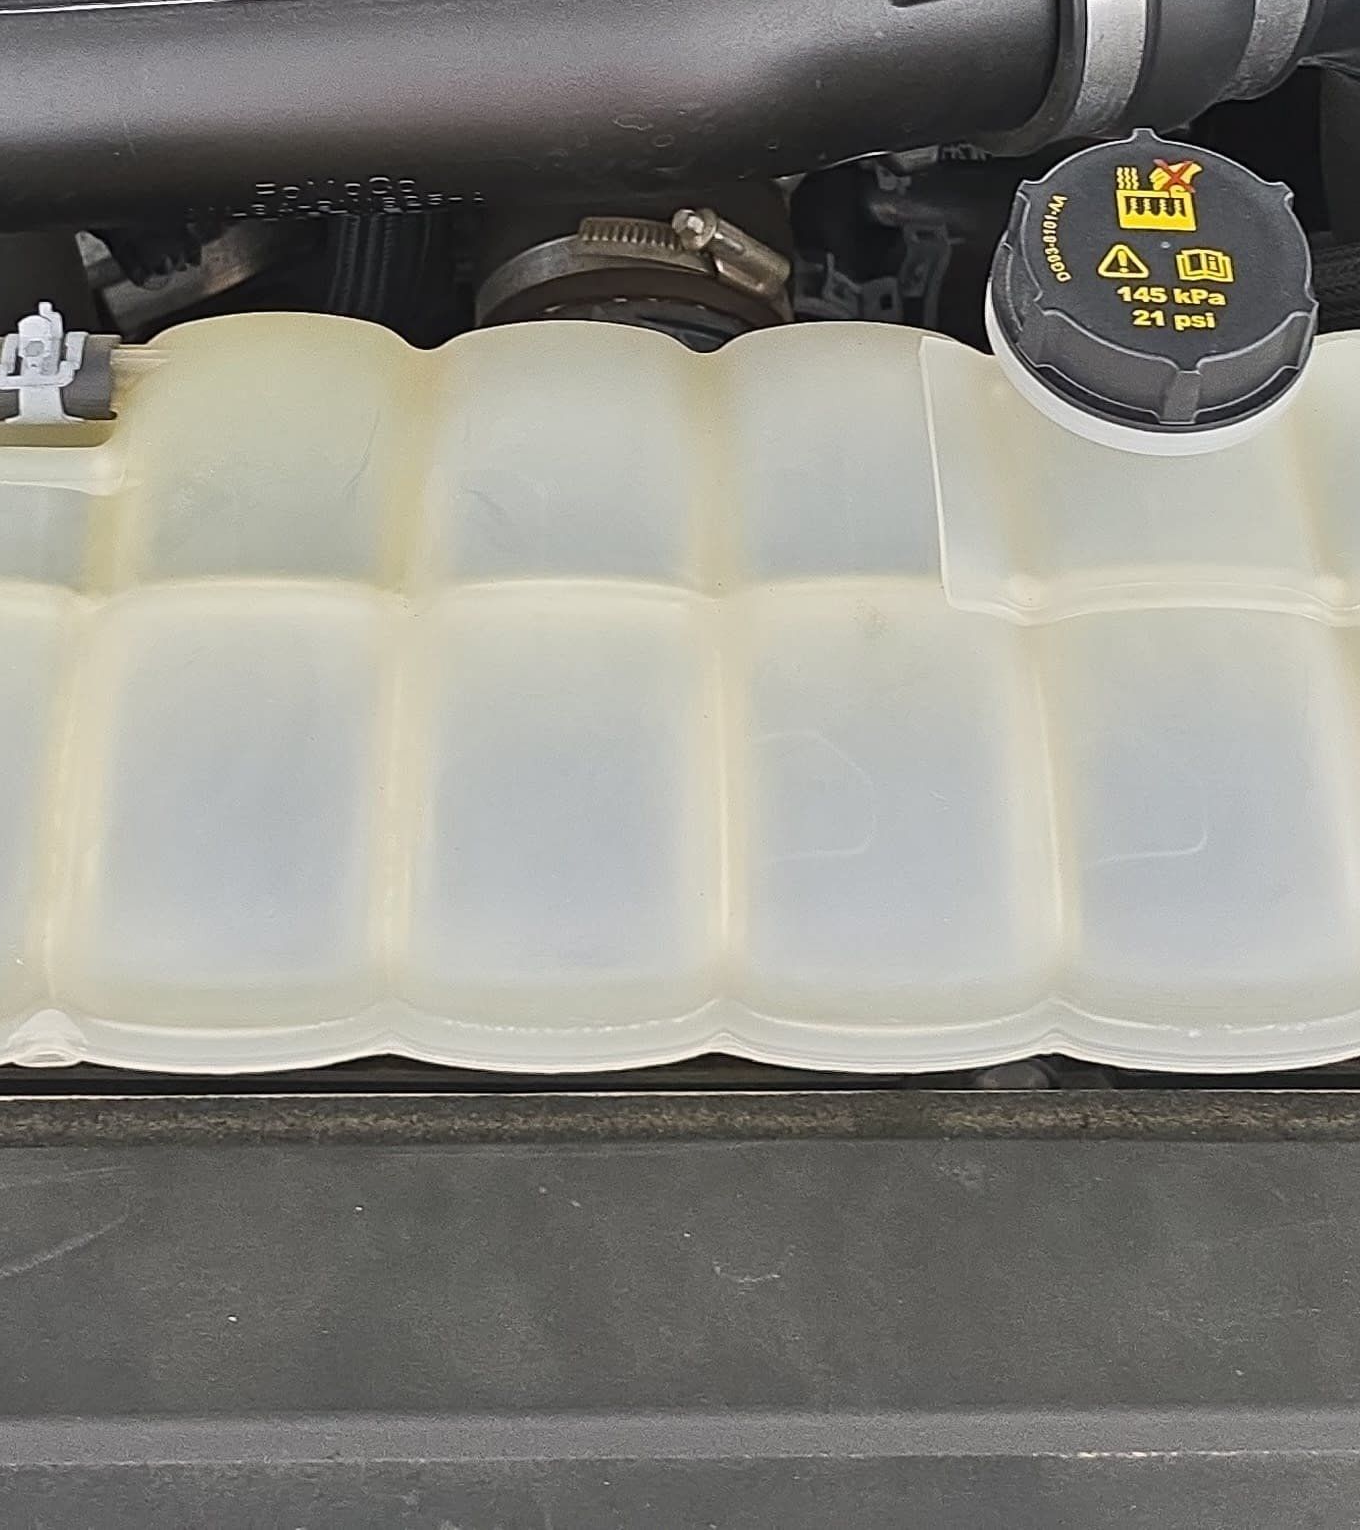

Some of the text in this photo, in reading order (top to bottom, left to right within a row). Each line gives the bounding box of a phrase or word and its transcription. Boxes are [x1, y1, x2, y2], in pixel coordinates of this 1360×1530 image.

[1117, 286, 1227, 306] 145 kPa
[1132, 309, 1216, 331] 21 psi
